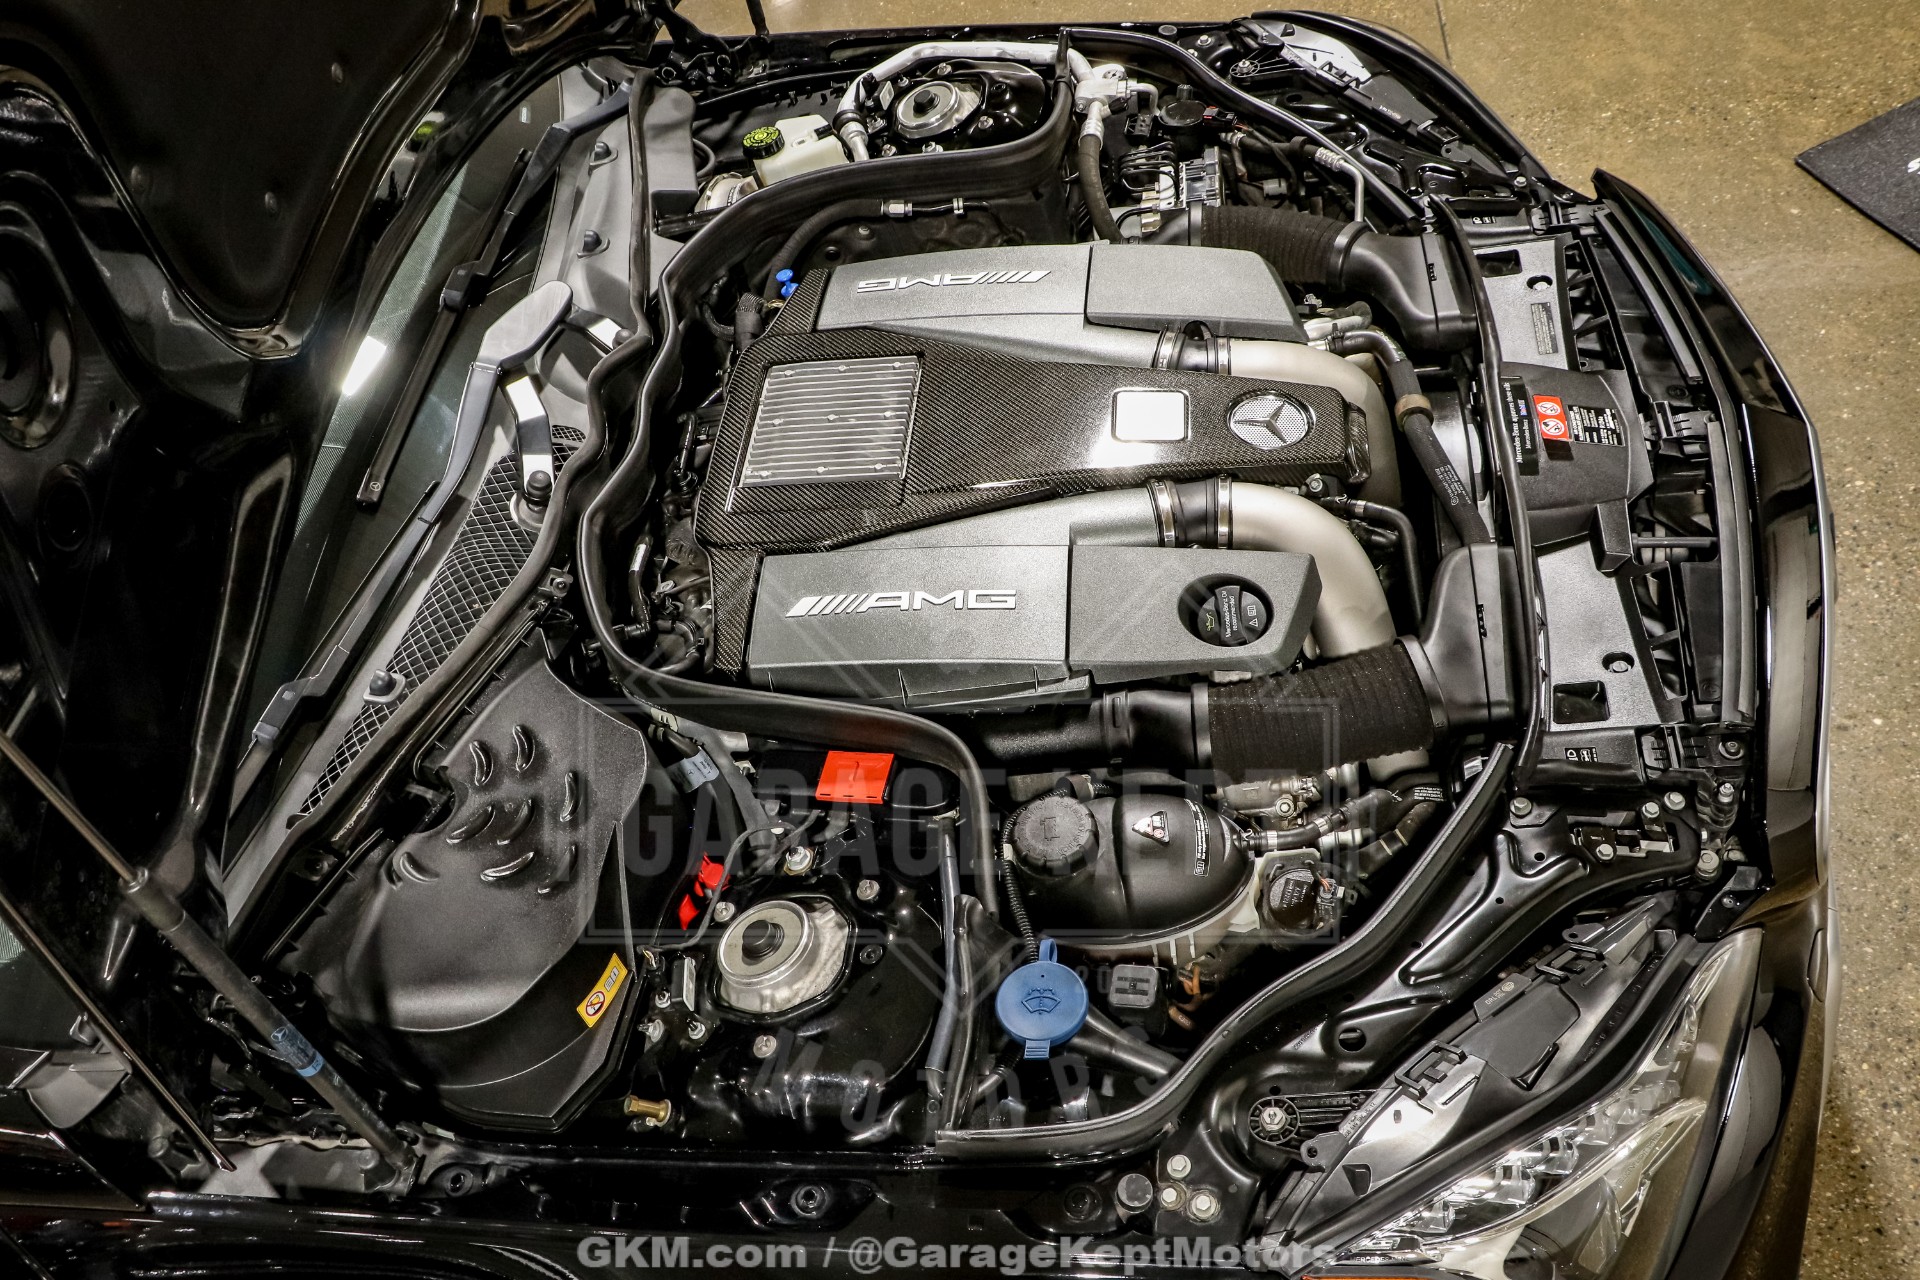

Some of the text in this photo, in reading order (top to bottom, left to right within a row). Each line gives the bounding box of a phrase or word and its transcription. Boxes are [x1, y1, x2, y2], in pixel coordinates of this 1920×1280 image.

[857, 268, 995, 293] AMG
[855, 589, 1017, 613] AMG
[1230, 596, 1238, 630] recommended
